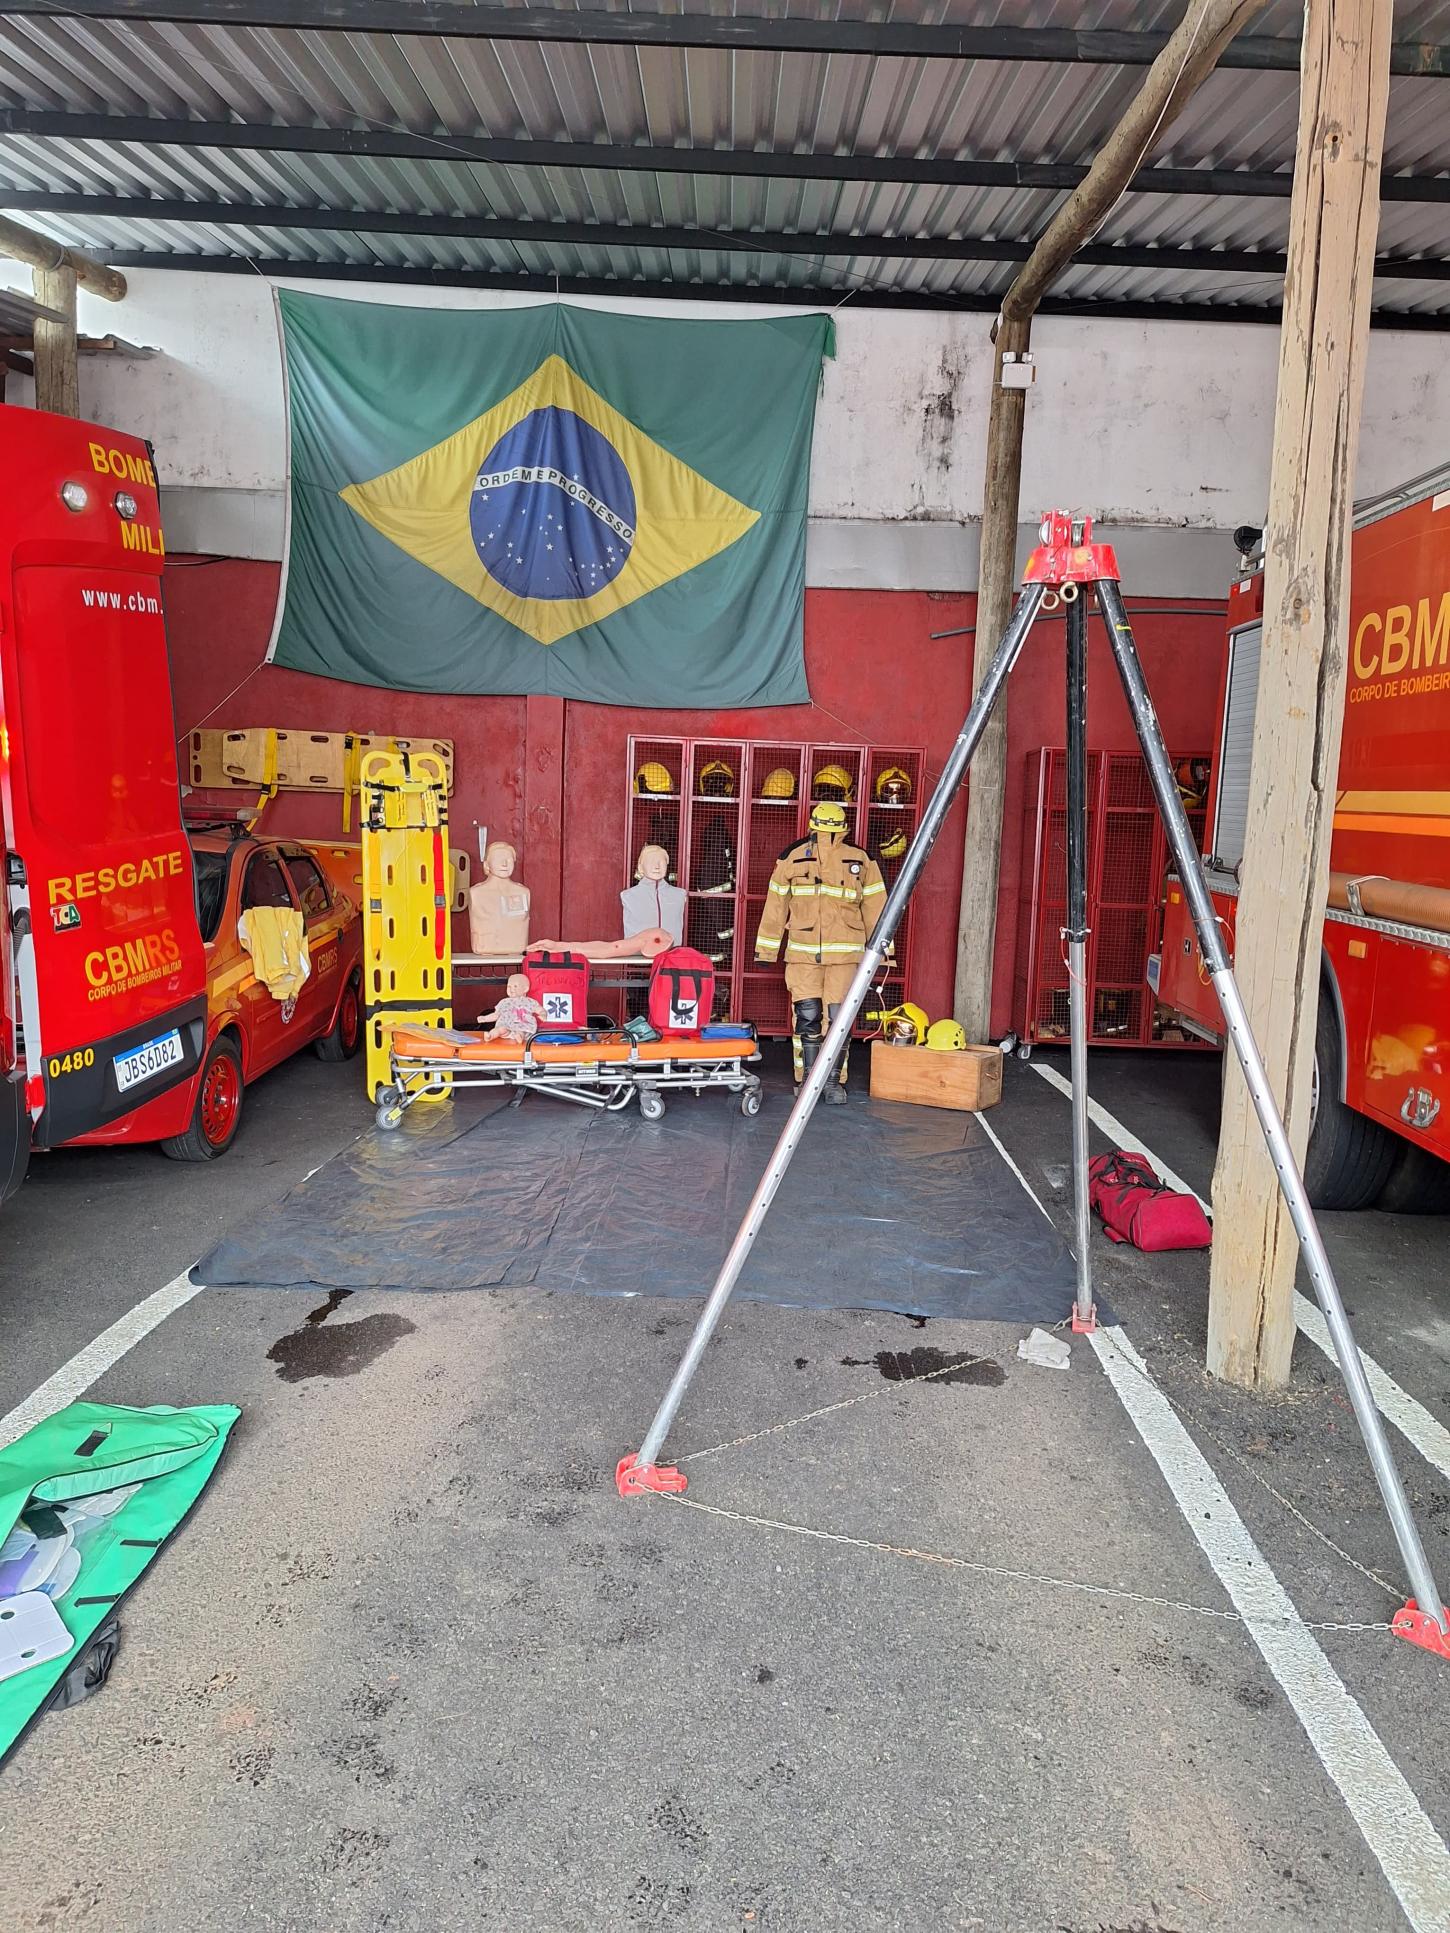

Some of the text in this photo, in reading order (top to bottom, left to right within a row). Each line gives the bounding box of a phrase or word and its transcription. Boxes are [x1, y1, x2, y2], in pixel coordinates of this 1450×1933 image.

[479, 468, 633, 539] ORDEM E PROGRESSO
[1350, 683, 1383, 704] CORPO
[1384, 680, 1399, 698] DE
[47, 851, 184, 905] RESGATE
[85, 928, 180, 987] CBMRS
[88, 959, 182, 1001] CORPO DE BOMBEIROS MILITAR
[49, 1047, 95, 1078] 0480
[124, 1039, 177, 1083] JBS6D82
